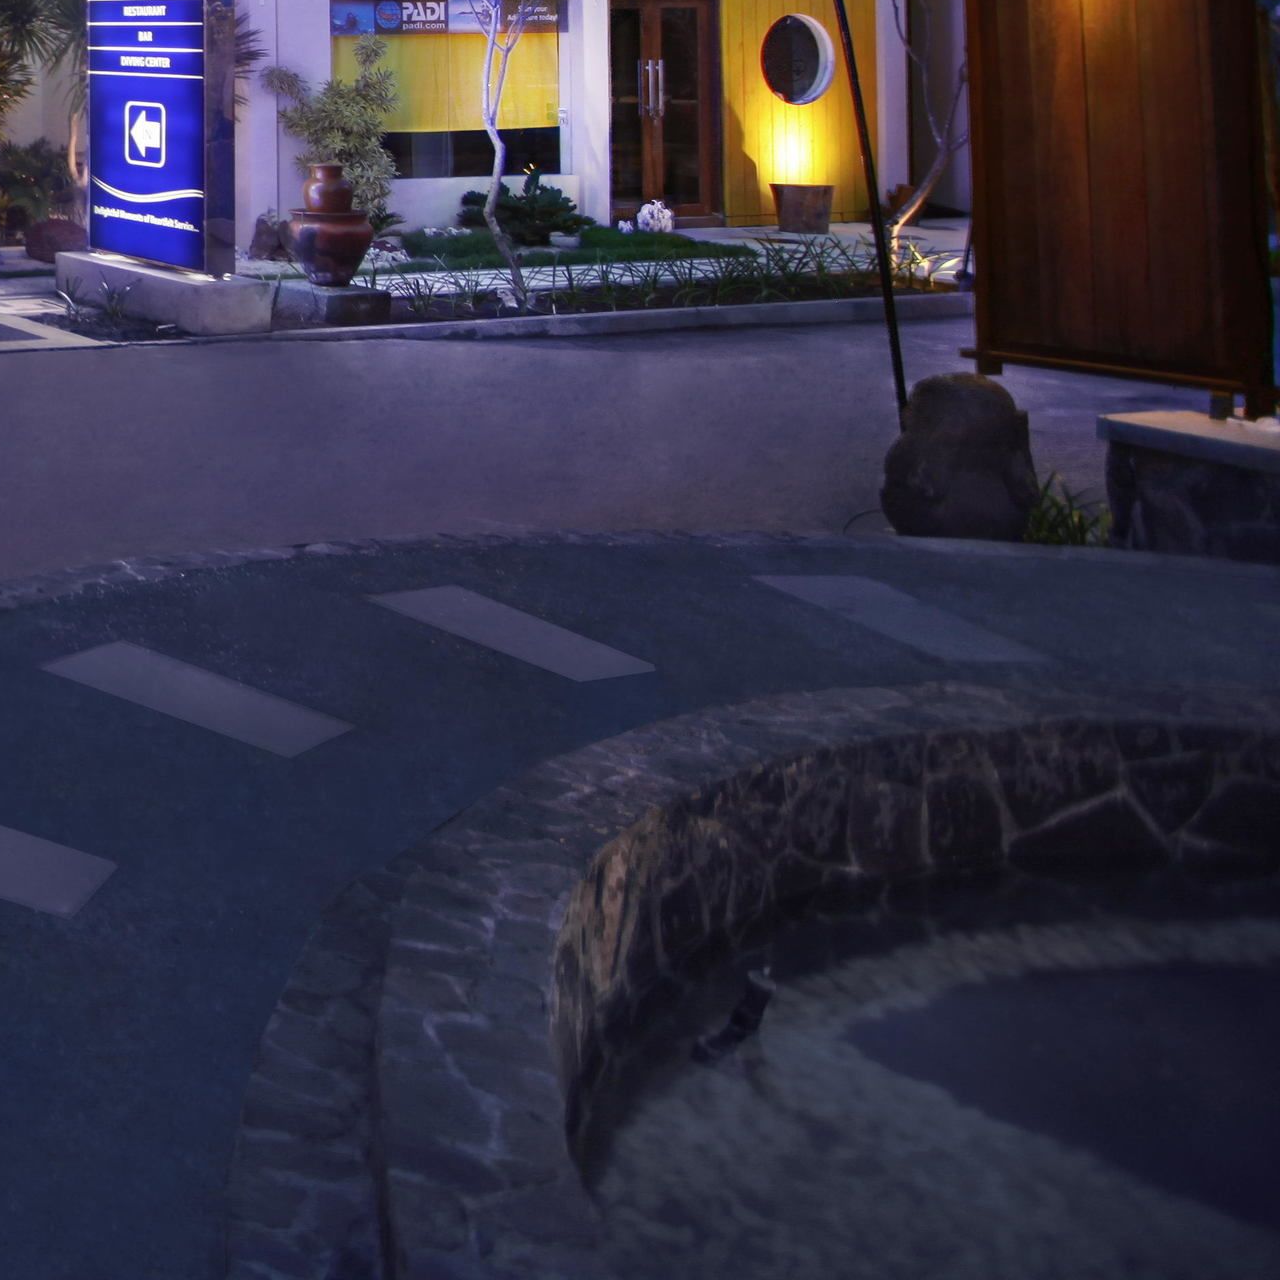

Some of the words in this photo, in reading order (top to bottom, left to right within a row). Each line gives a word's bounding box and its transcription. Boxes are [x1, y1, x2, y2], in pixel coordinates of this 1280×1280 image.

[123, 6, 166, 16] RESTAURANT
[402, 2, 445, 21] PADI
[402, 22, 446, 31] padi.com
[138, 31, 153, 42] BAR
[120, 56, 145, 67] DIVING
[145, 57, 170, 68] CENTER
